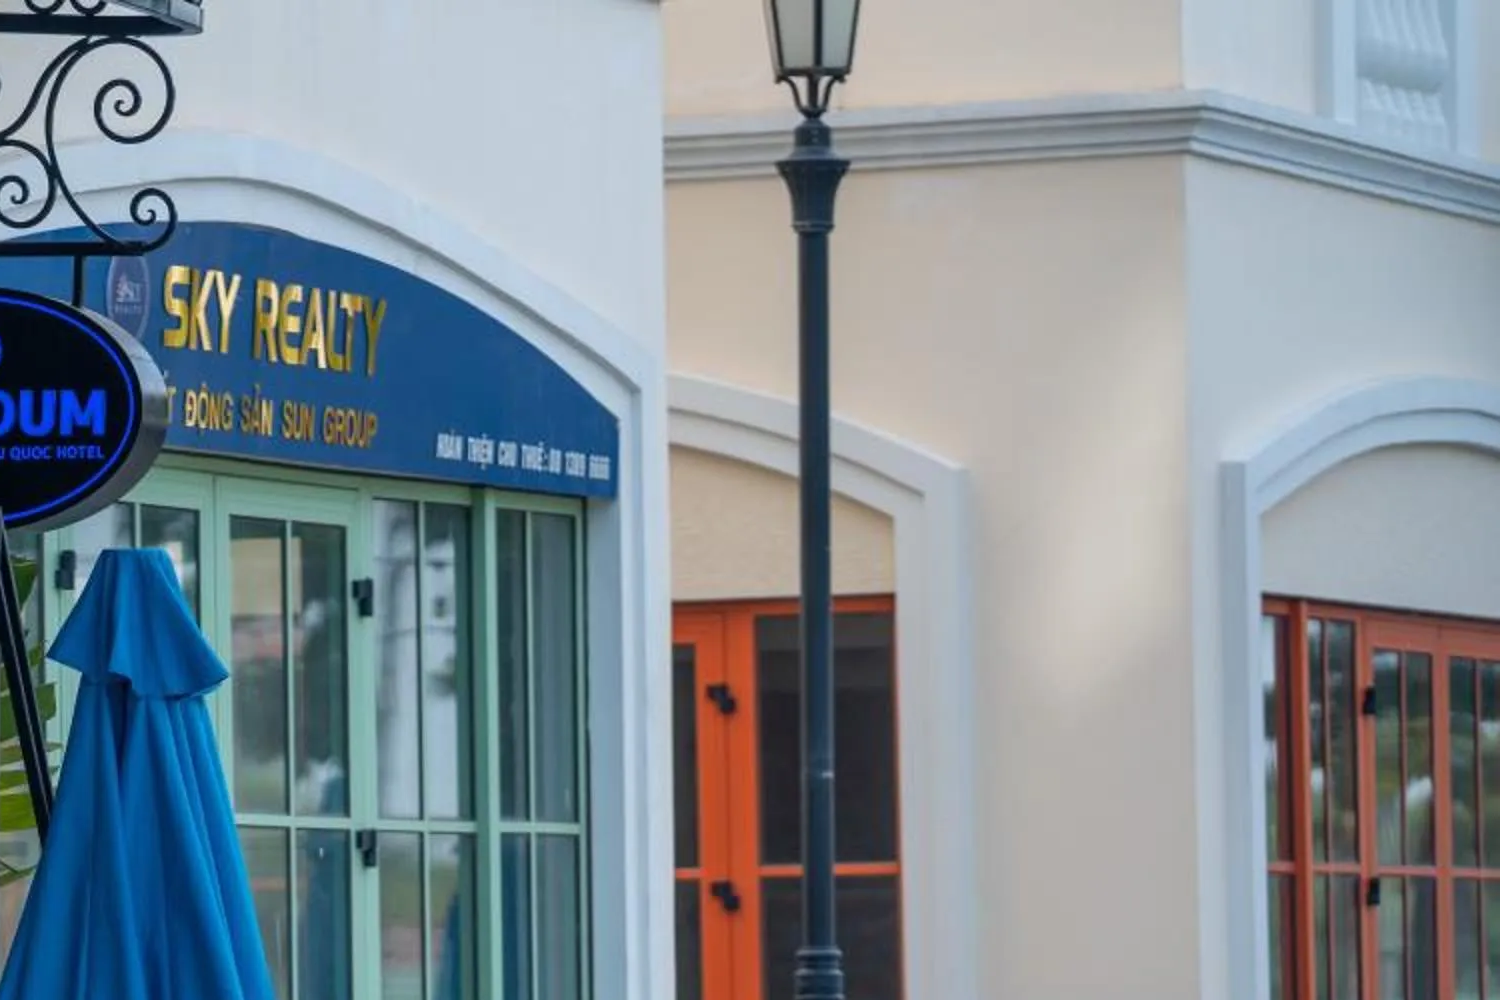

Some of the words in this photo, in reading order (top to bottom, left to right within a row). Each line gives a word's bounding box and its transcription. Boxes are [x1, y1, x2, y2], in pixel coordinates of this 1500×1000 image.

[163, 265, 242, 354] SKY
[254, 278, 388, 377] REALTY
[240, 383, 274, 437] SẢN
[282, 399, 316, 442] SUN
[323, 404, 378, 448] GROUP
[10, 445, 53, 460] QUOC
[56, 444, 105, 460] HOTEL
